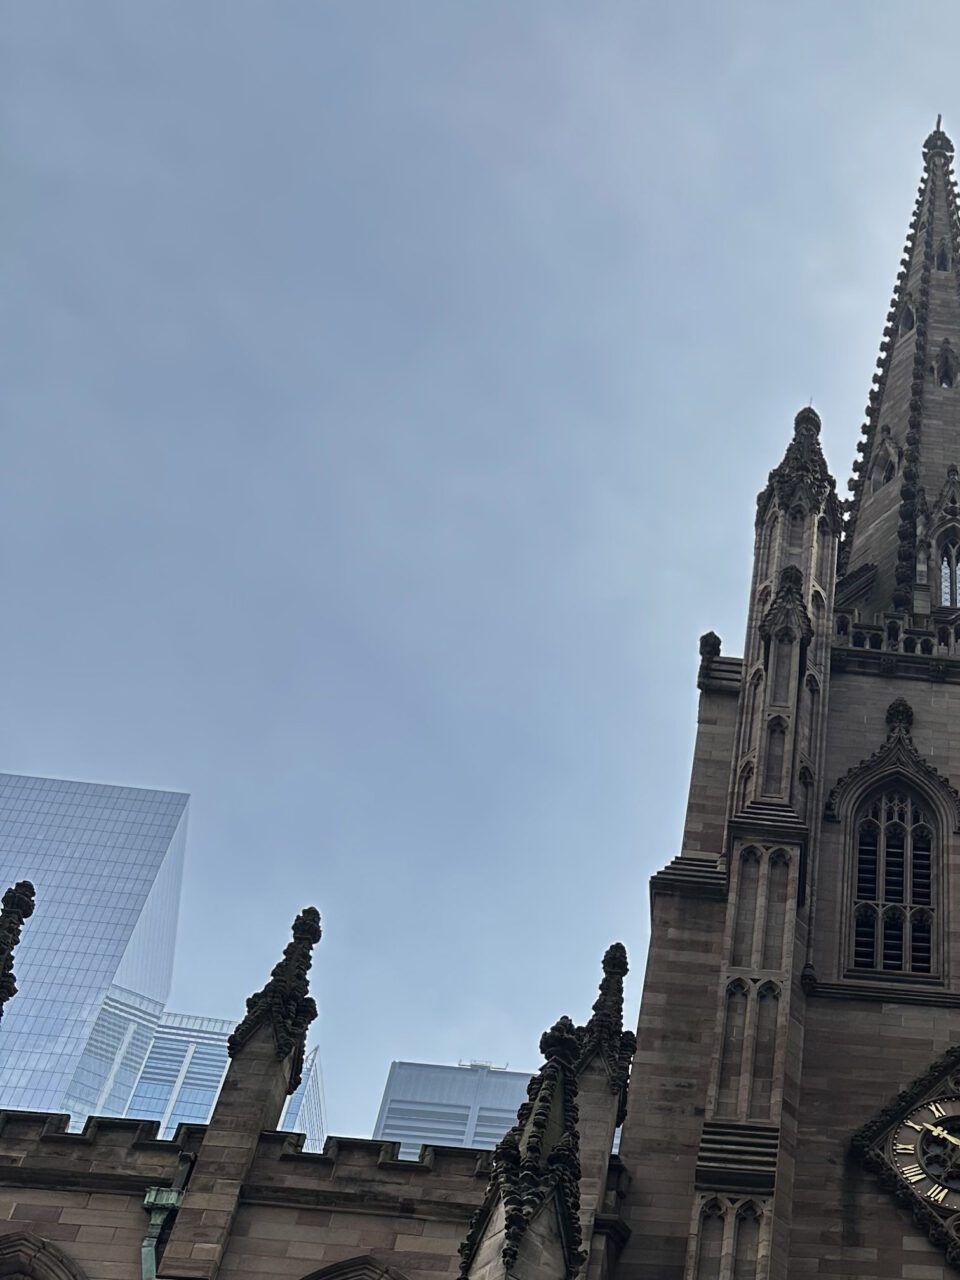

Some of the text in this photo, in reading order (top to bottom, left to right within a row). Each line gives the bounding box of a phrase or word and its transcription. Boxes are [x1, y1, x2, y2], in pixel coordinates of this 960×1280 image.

[928, 1103, 946, 1118] XI
[904, 1120, 923, 1132] X
[896, 1143, 915, 1154] IX
[901, 1163, 927, 1183] VIII
[926, 1184, 949, 1203] VII
